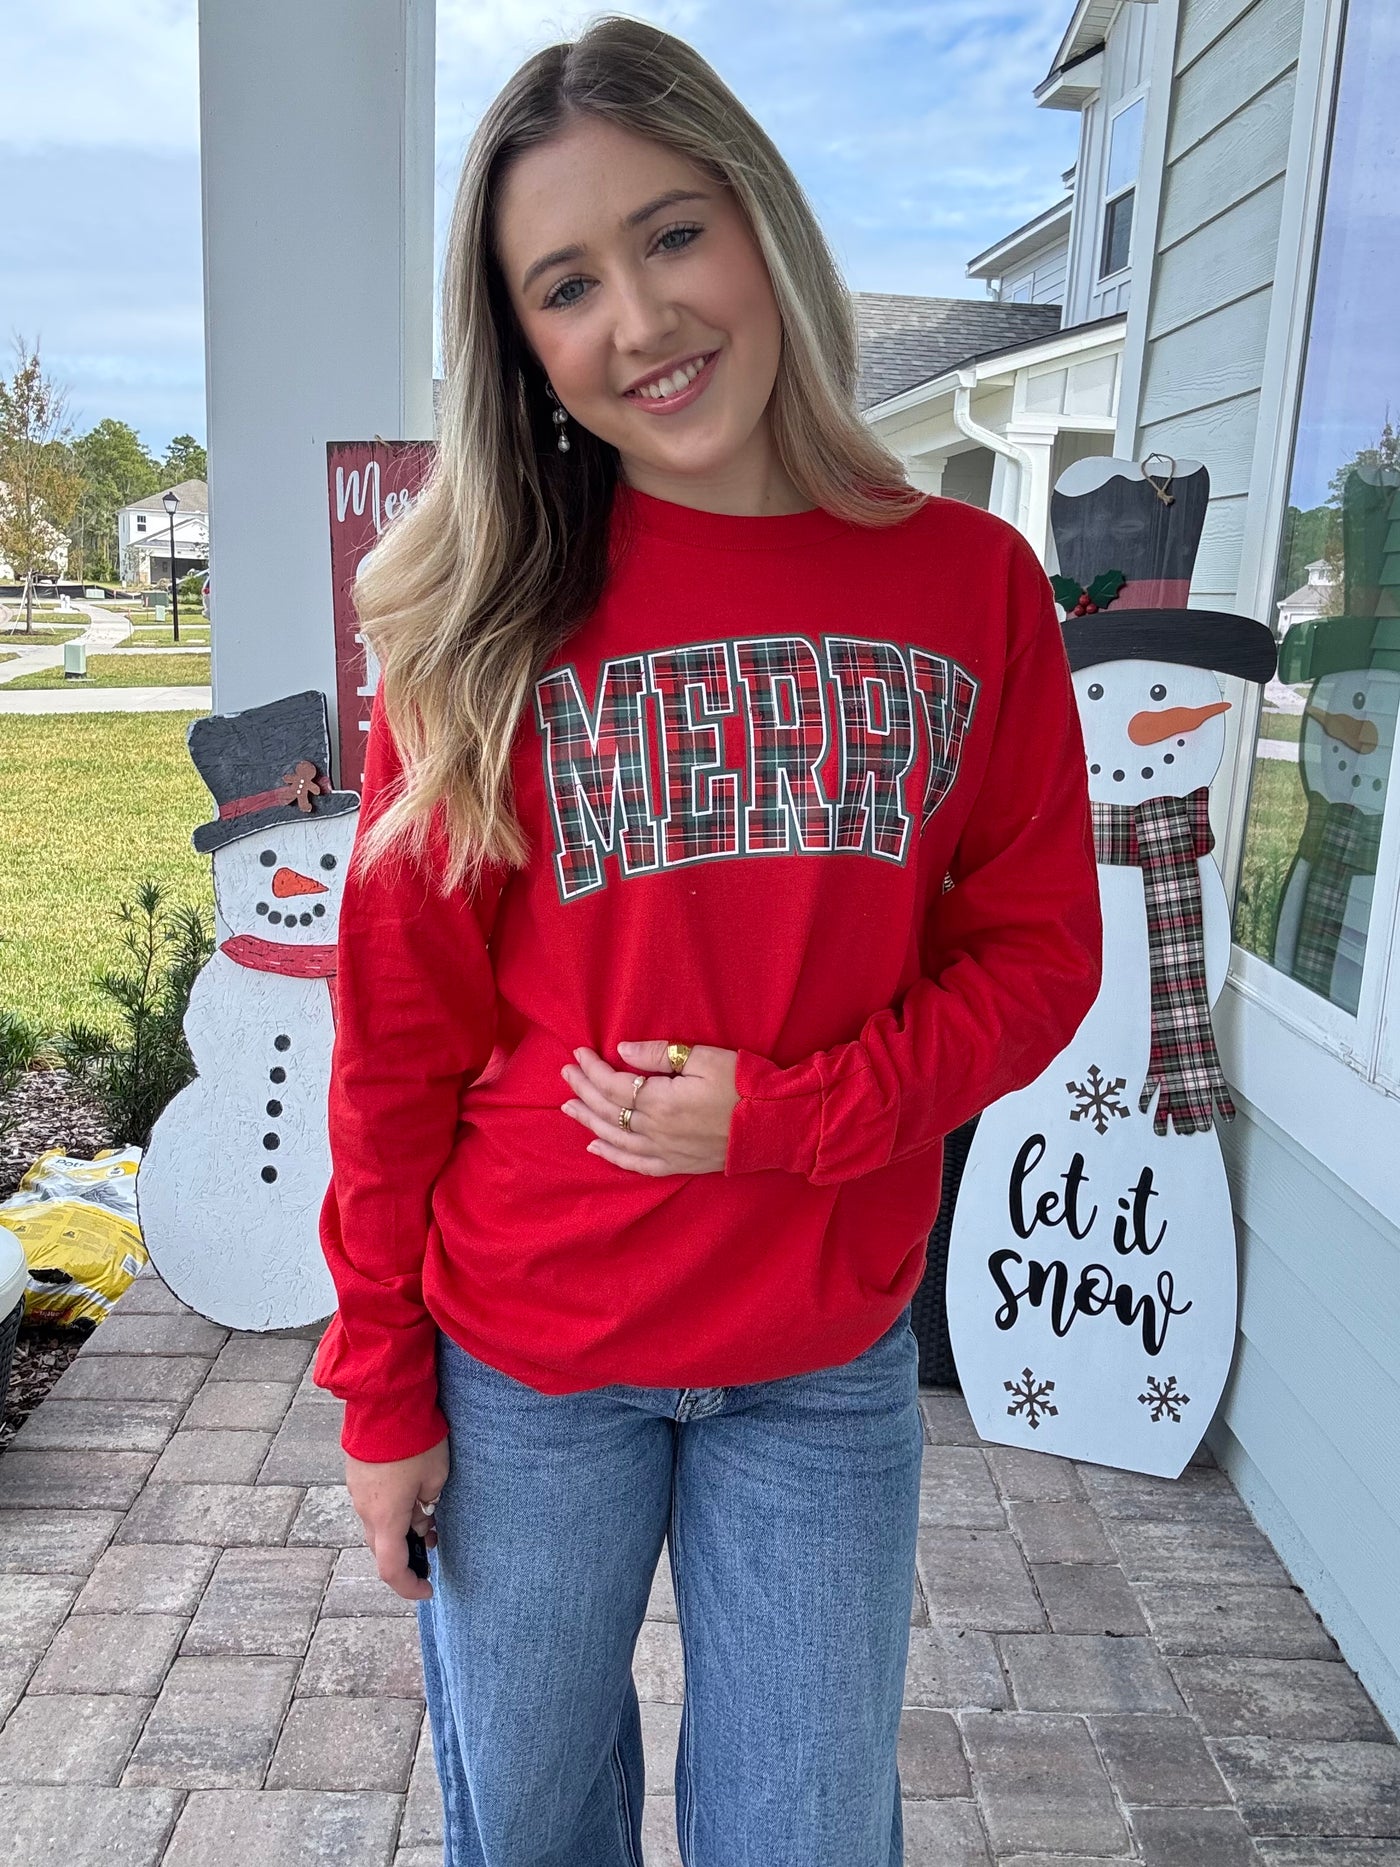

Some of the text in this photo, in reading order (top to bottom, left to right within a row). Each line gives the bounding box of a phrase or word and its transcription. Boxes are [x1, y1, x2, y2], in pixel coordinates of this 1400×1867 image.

[336, 461, 427, 535] Mer
[534, 632, 981, 904] MERRY
[1009, 1133, 1168, 1255] let it
[988, 1249, 1193, 1356] snow
